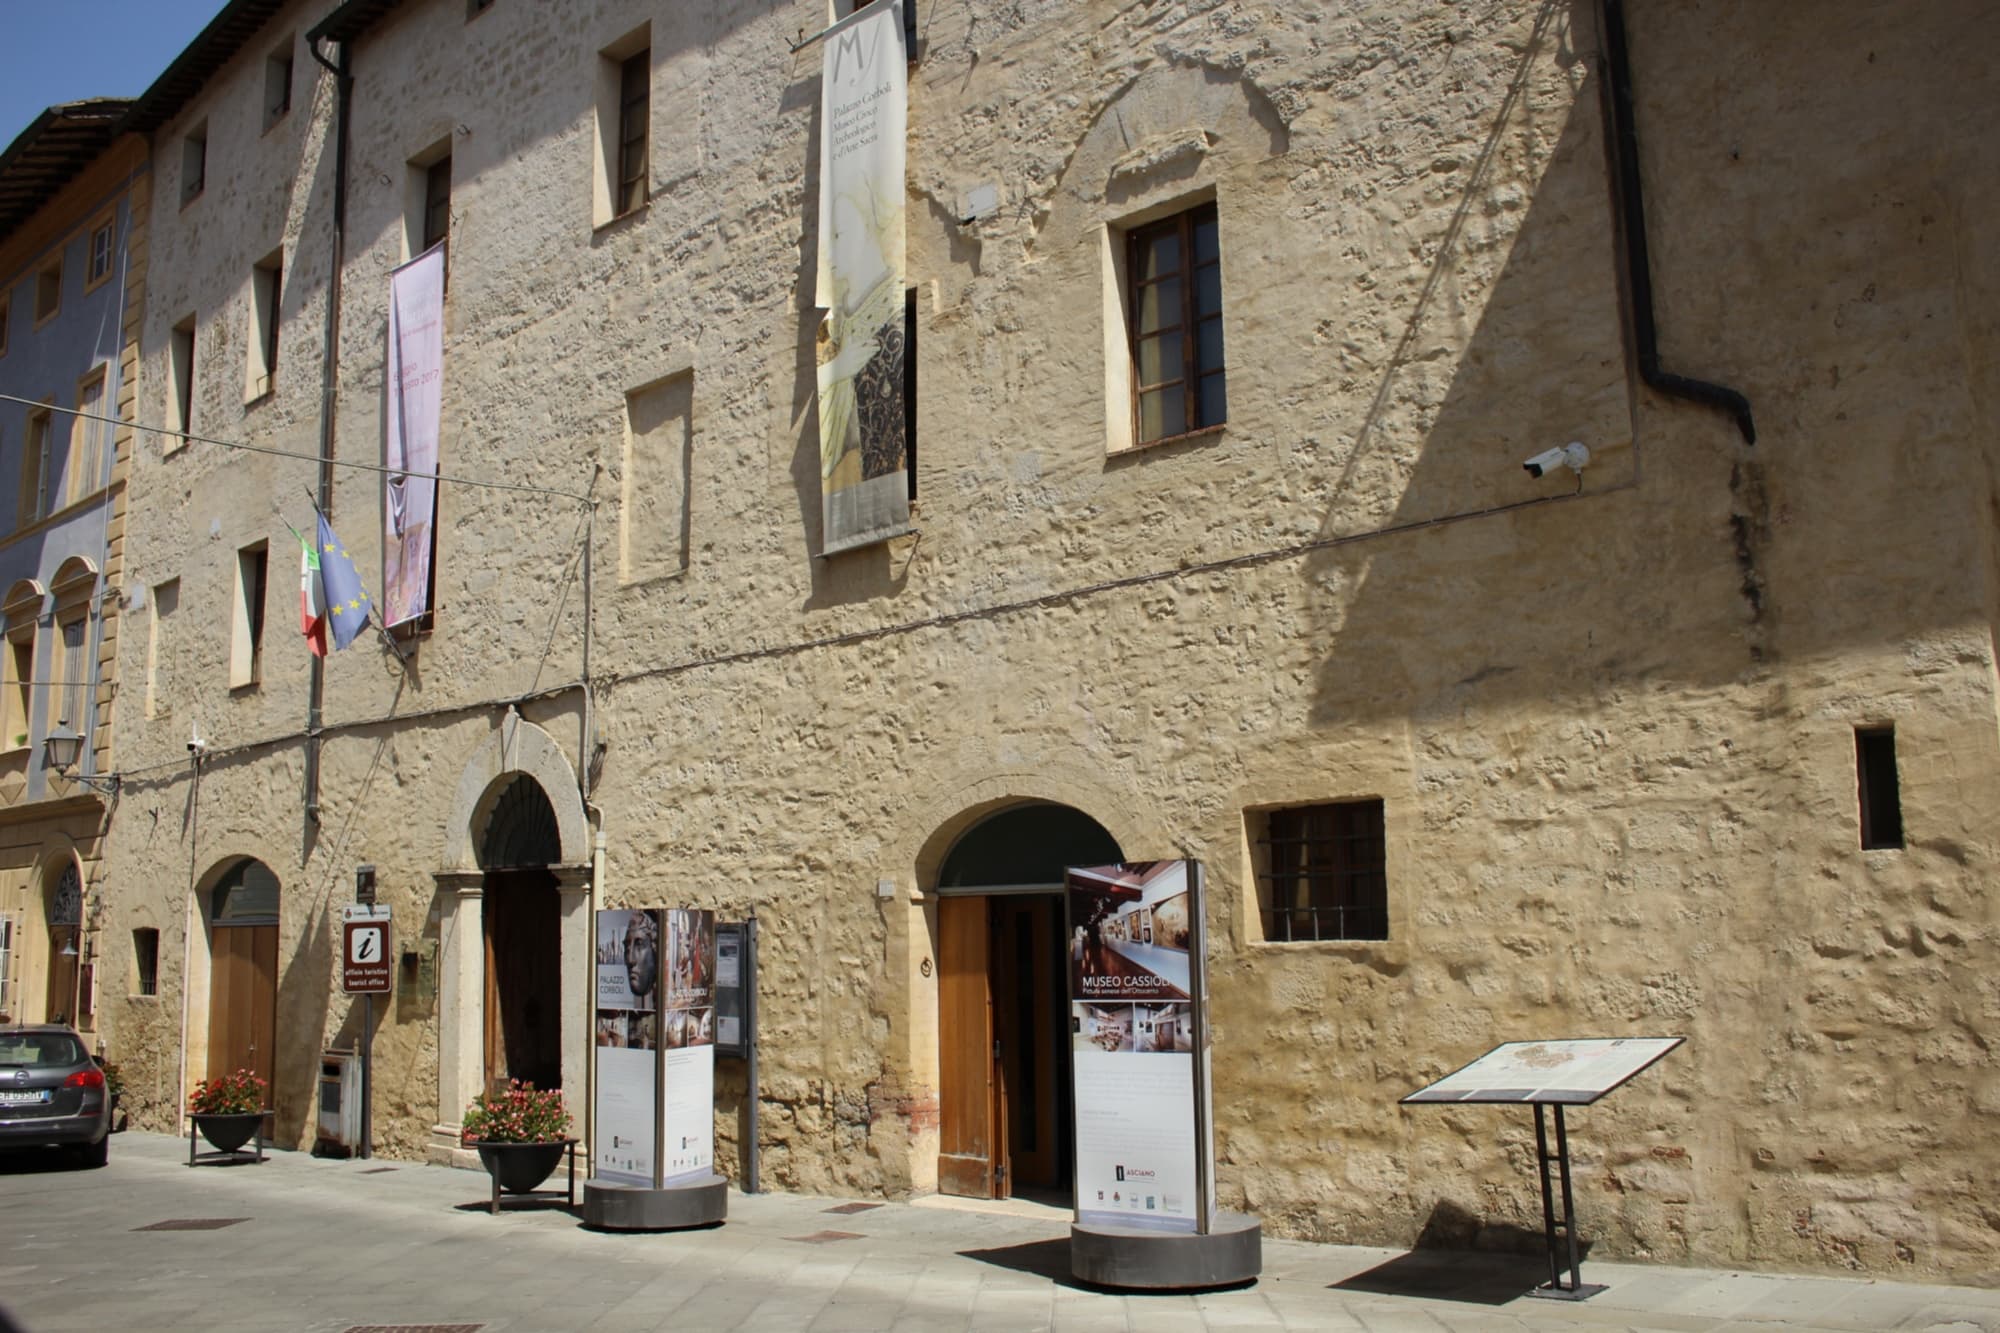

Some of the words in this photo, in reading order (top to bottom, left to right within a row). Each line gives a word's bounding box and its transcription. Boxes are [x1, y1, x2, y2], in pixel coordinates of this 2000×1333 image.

[862, 81, 892, 105] Corboli
[368, 978, 385, 986] office
[1082, 976, 1121, 987] MUSEO
